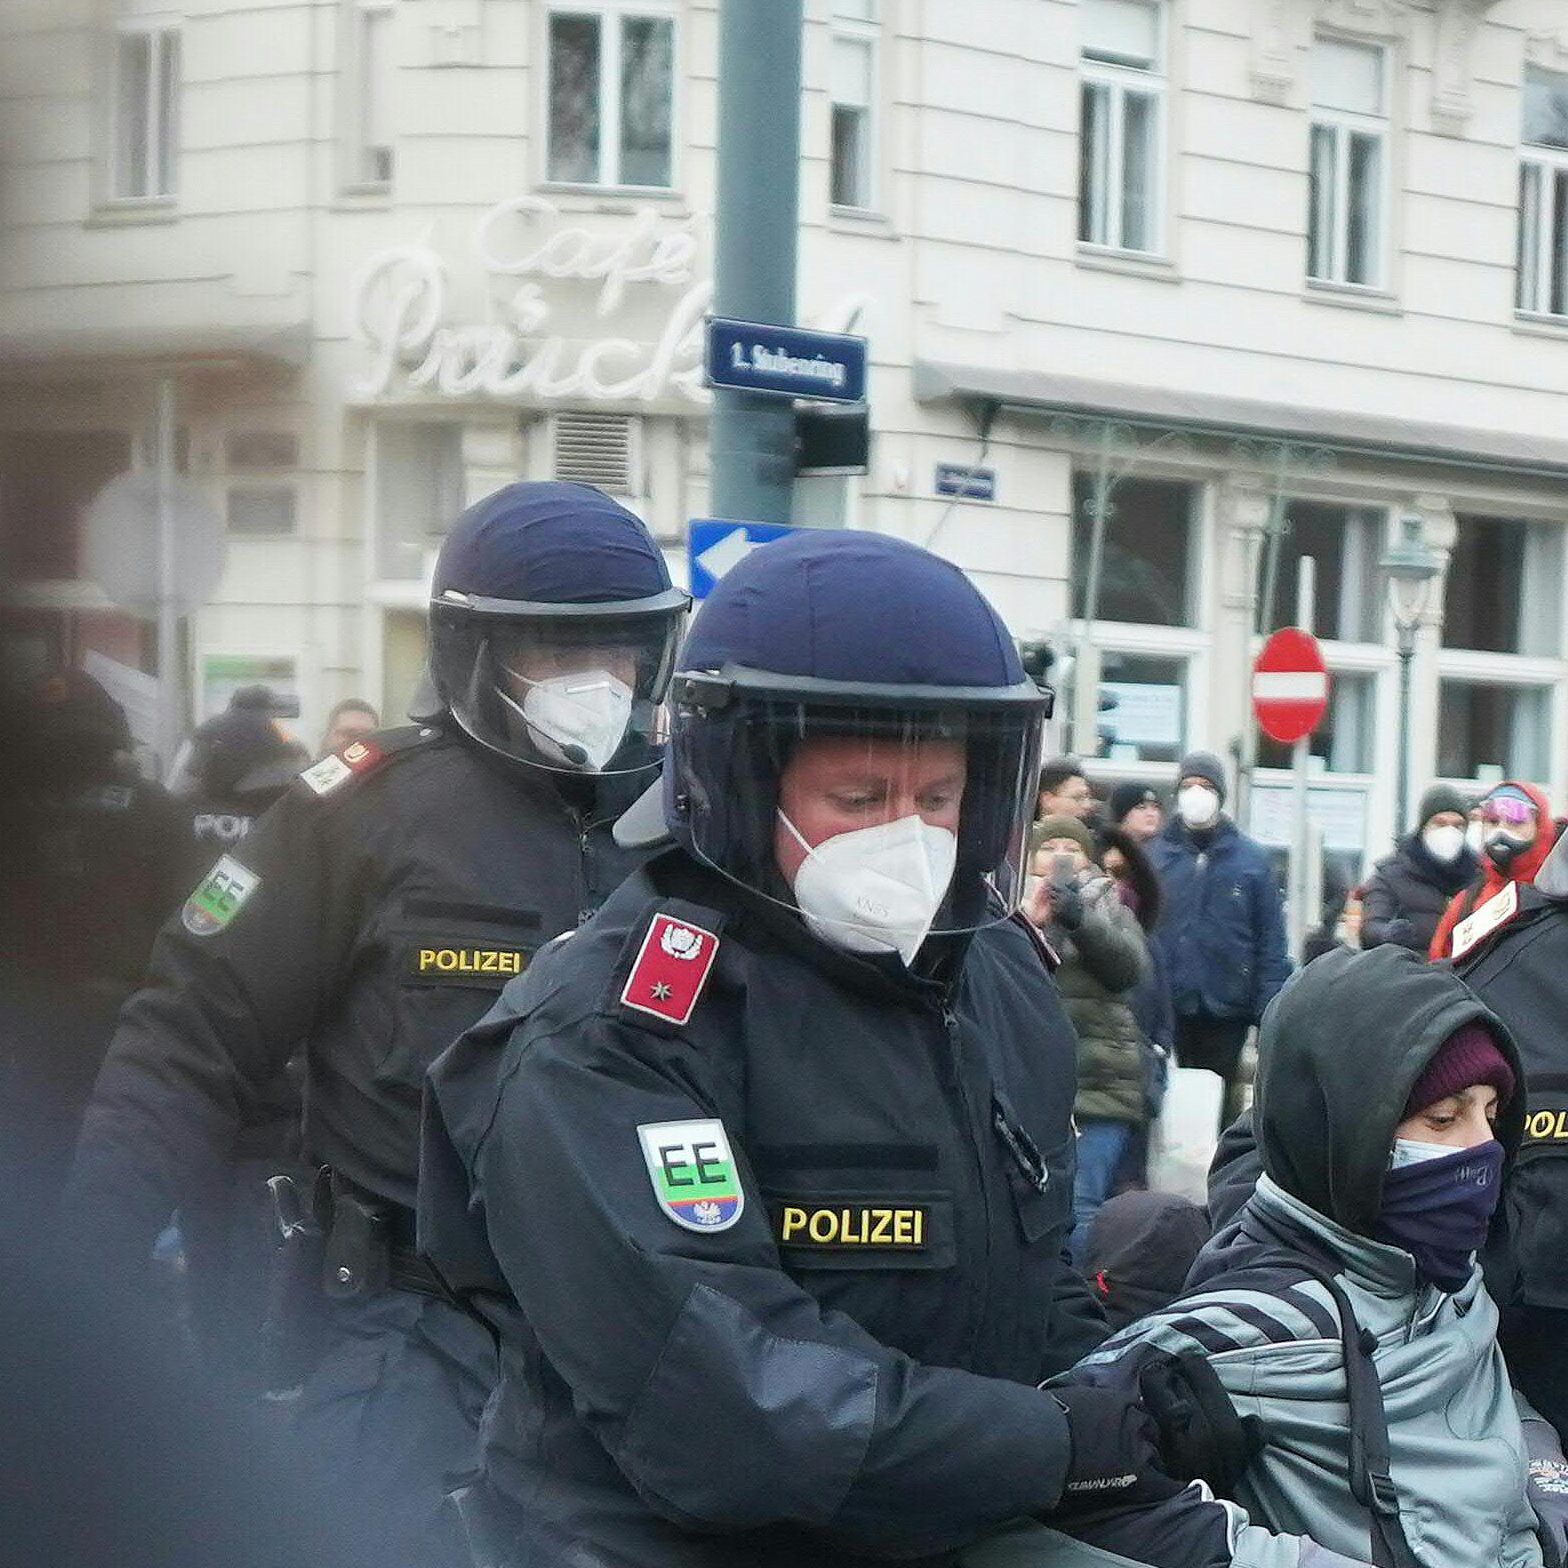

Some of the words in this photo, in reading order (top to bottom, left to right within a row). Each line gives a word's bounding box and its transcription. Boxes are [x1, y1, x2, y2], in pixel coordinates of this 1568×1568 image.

[419, 949, 521, 975] POLIZEI
[658, 1141, 727, 1187] EE
[782, 1207, 923, 1245] POLIZEI
